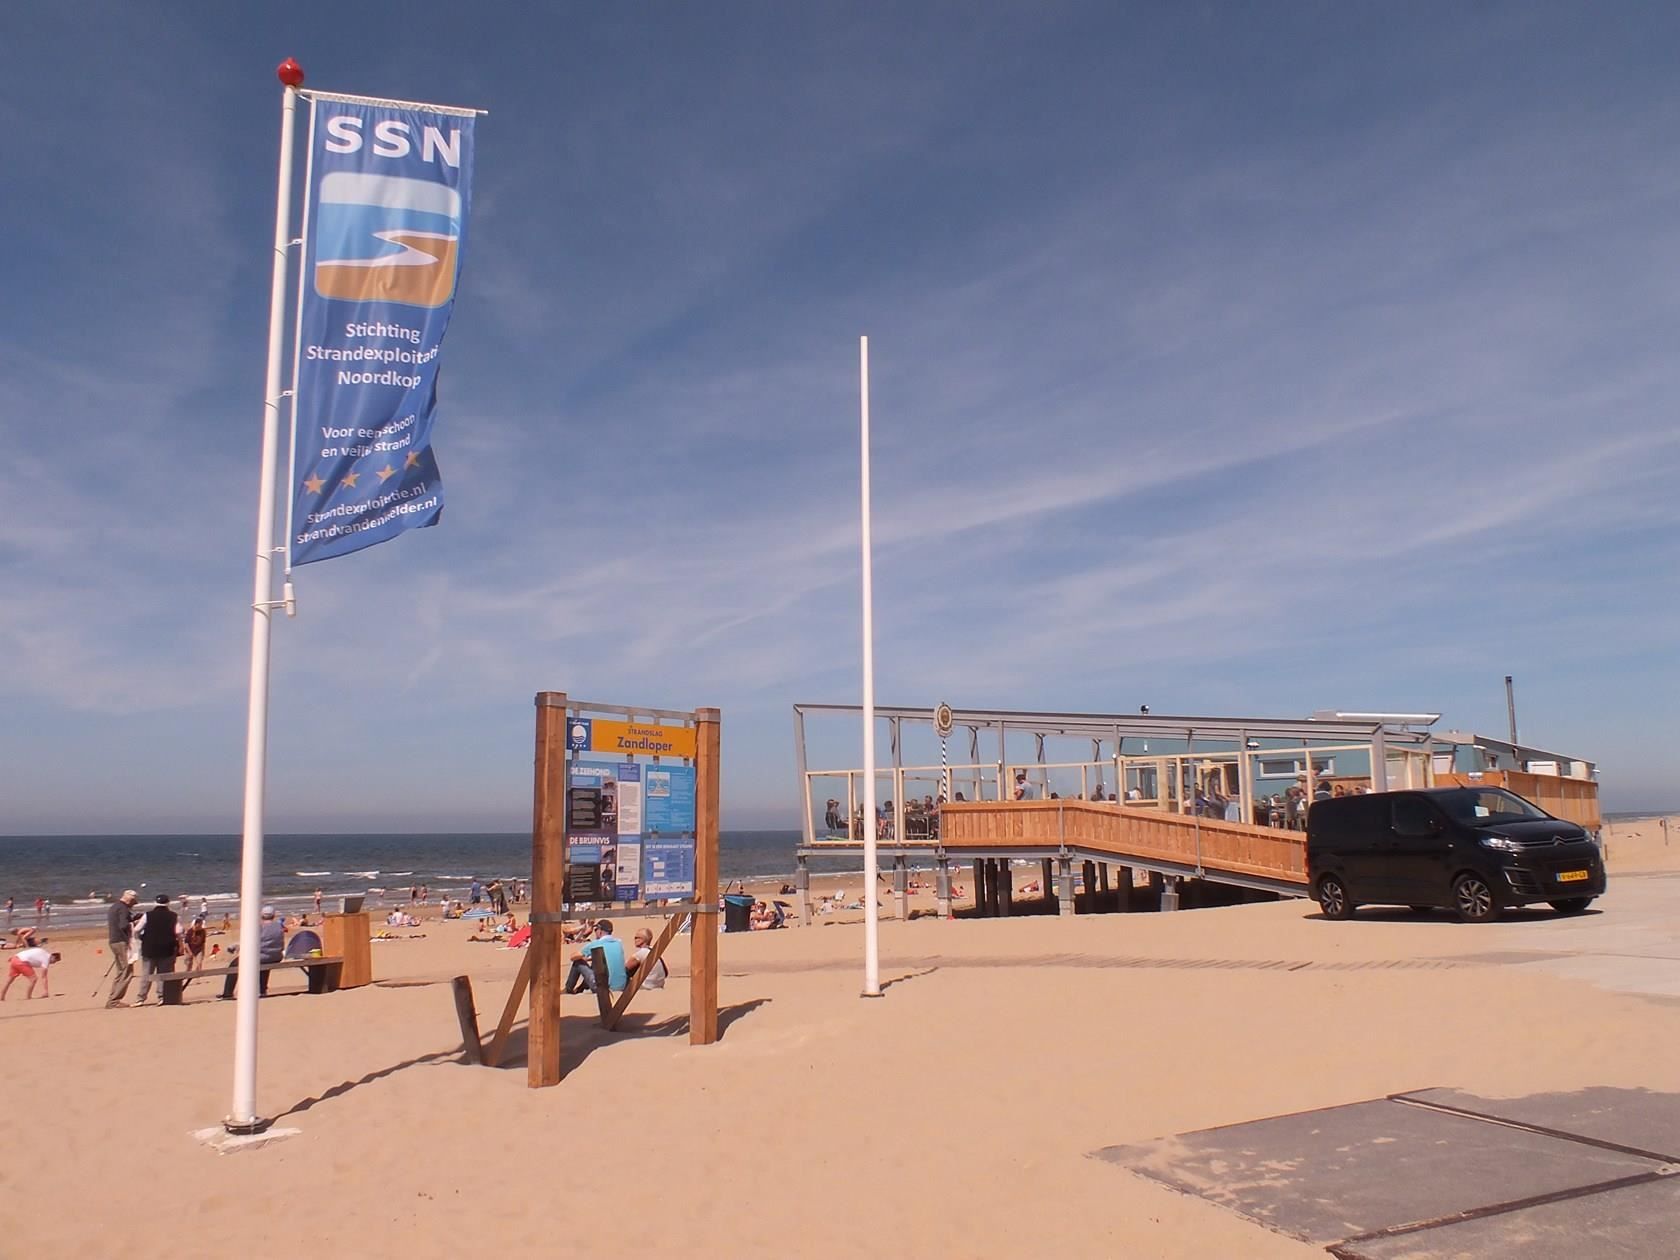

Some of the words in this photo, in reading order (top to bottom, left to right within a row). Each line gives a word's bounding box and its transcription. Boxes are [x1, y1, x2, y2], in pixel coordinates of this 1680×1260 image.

[325, 115, 461, 169] SSN
[345, 322, 421, 344] Stichting
[306, 344, 439, 365] Strandexploitati
[338, 370, 421, 390] Noordkop
[321, 426, 355, 439] Voor
[358, 428, 382, 439] een
[382, 413, 416, 435] schoon
[321, 446, 338, 458] en
[374, 432, 411, 452] strand
[616, 735, 673, 754] Zandloper
[569, 836, 578, 845] DE
[579, 836, 610, 846] BRUINVIS
